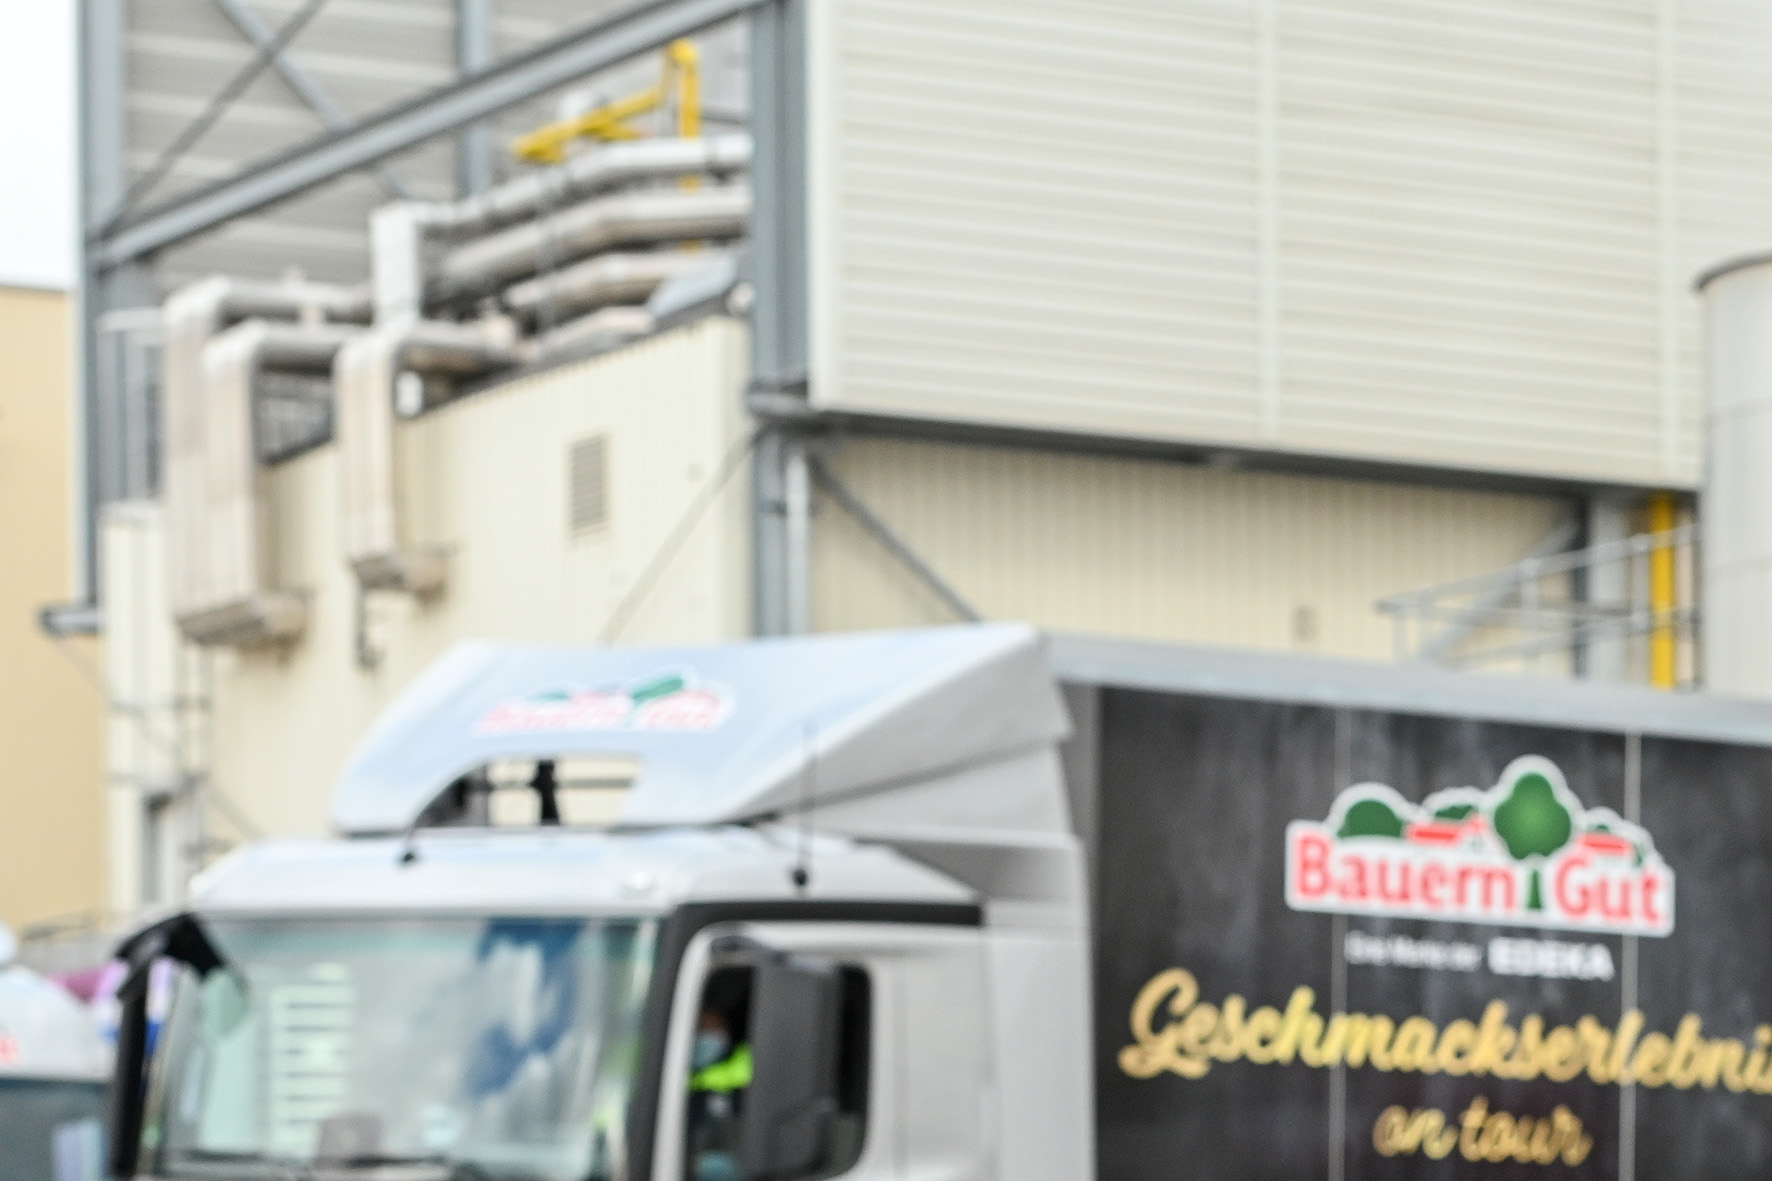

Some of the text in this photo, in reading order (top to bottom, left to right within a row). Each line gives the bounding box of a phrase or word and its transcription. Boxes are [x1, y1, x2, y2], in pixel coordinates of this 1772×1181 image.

[1553, 851, 1663, 925] Gut
[1371, 1095, 1594, 1167] on tour
